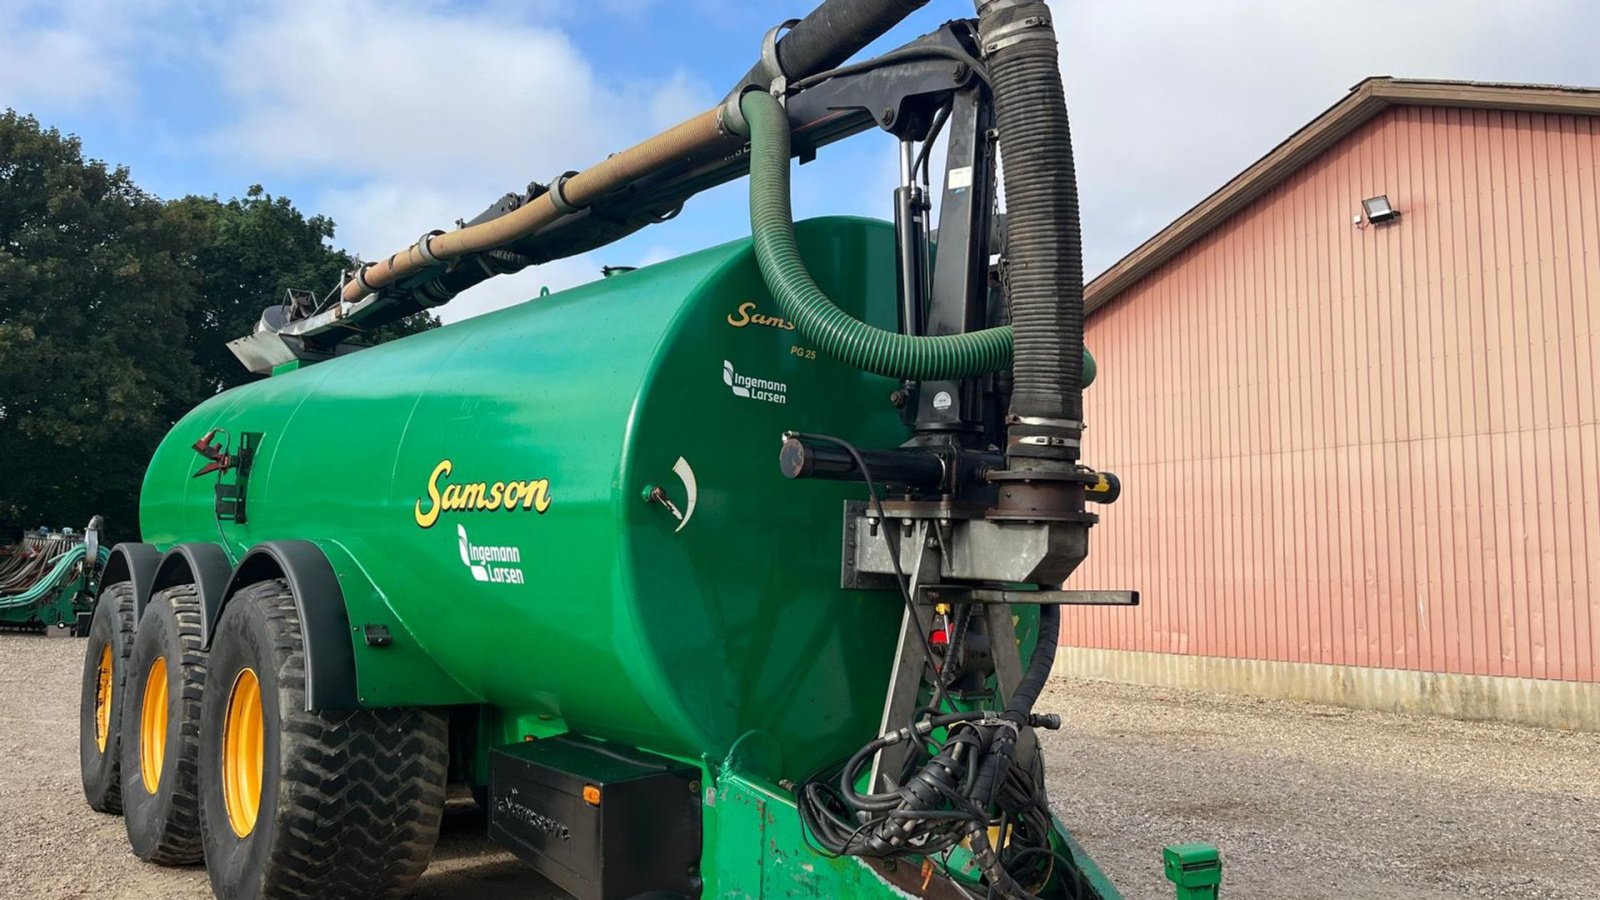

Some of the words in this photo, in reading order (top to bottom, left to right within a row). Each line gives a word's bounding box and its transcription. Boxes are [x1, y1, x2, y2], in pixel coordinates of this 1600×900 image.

[727, 301, 796, 331] Sams
[790, 346, 804, 357] PG
[805, 350, 817, 360] 25
[734, 373, 787, 393] Ingemann
[751, 388, 786, 404] Larsen
[414, 459, 552, 529] Samson
[469, 542, 521, 565] Ingemann
[488, 563, 525, 584] Larsen
